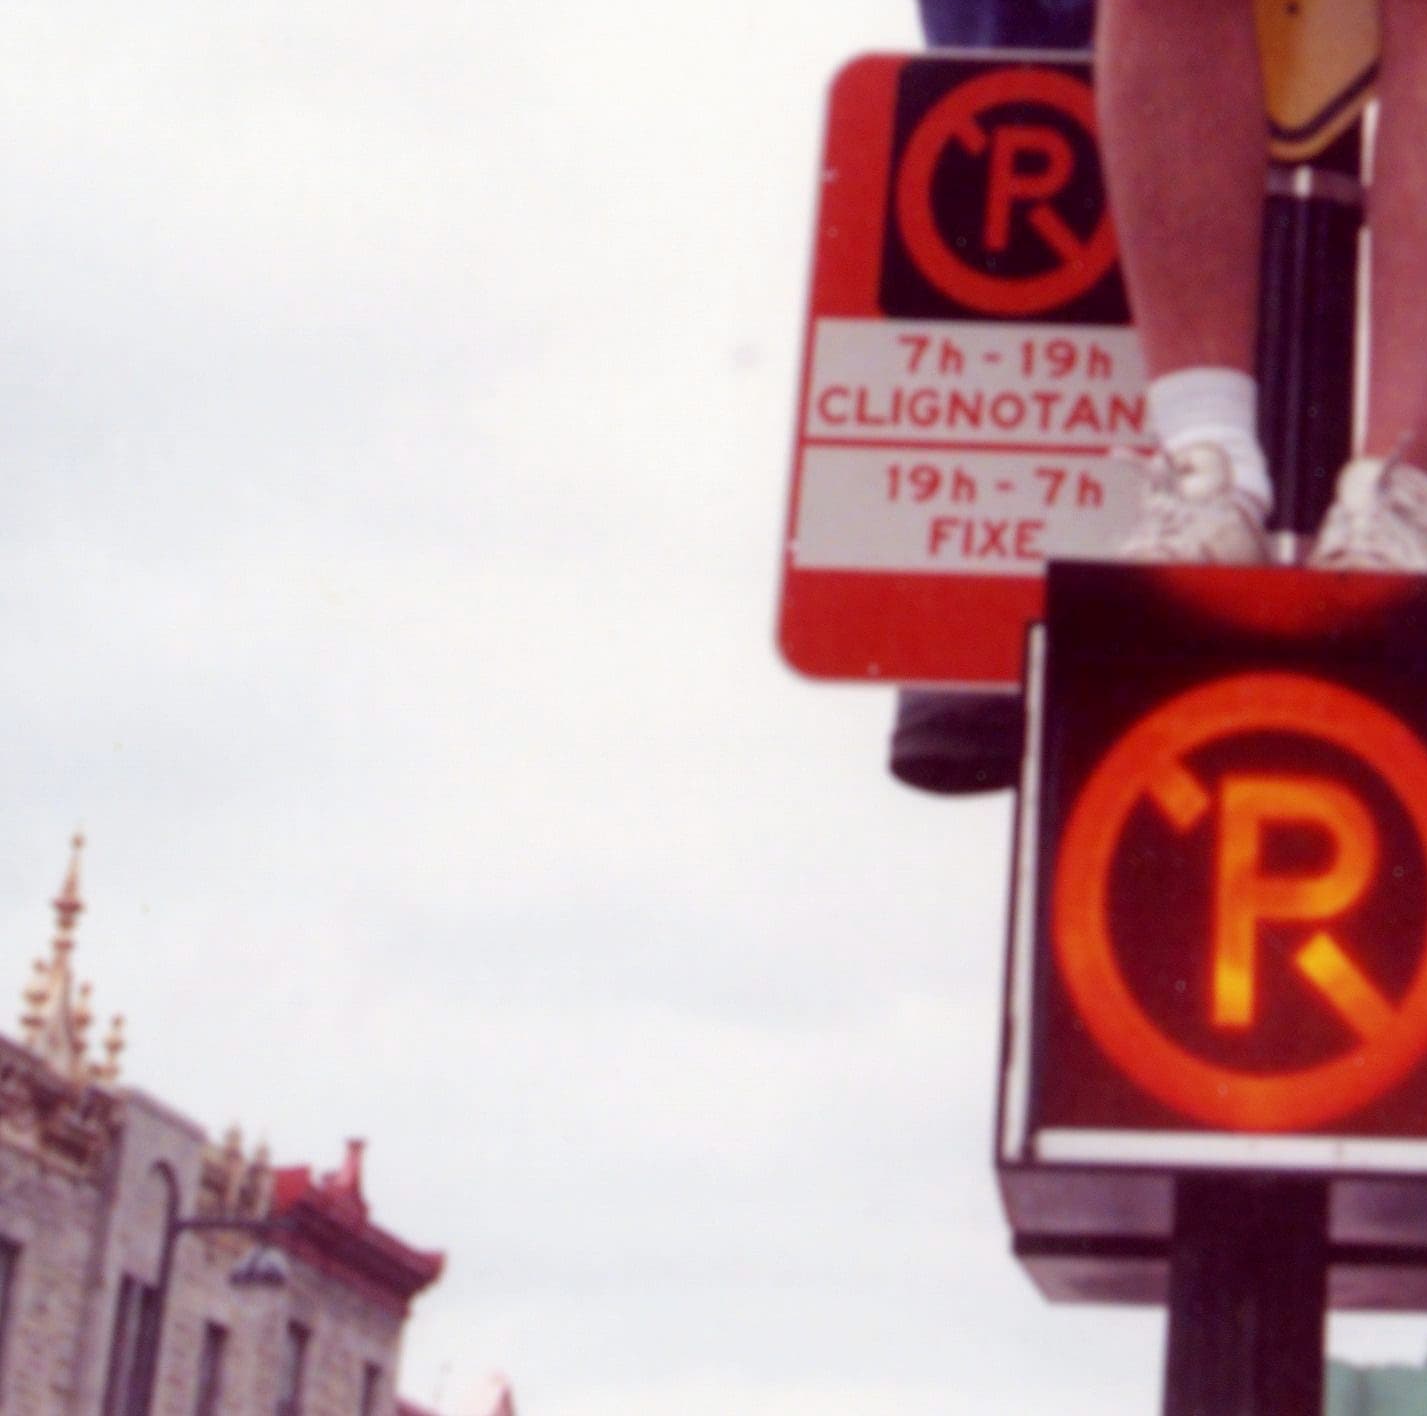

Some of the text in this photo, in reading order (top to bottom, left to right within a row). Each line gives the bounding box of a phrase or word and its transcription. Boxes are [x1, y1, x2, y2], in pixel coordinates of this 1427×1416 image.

[899, 334, 964, 378] 7h
[1021, 338, 1114, 380] 19h
[816, 385, 1147, 435] CLIGNOTAN
[887, 463, 978, 505] 19h
[1035, 465, 1105, 509] 7h
[927, 516, 1046, 559] FIXE
